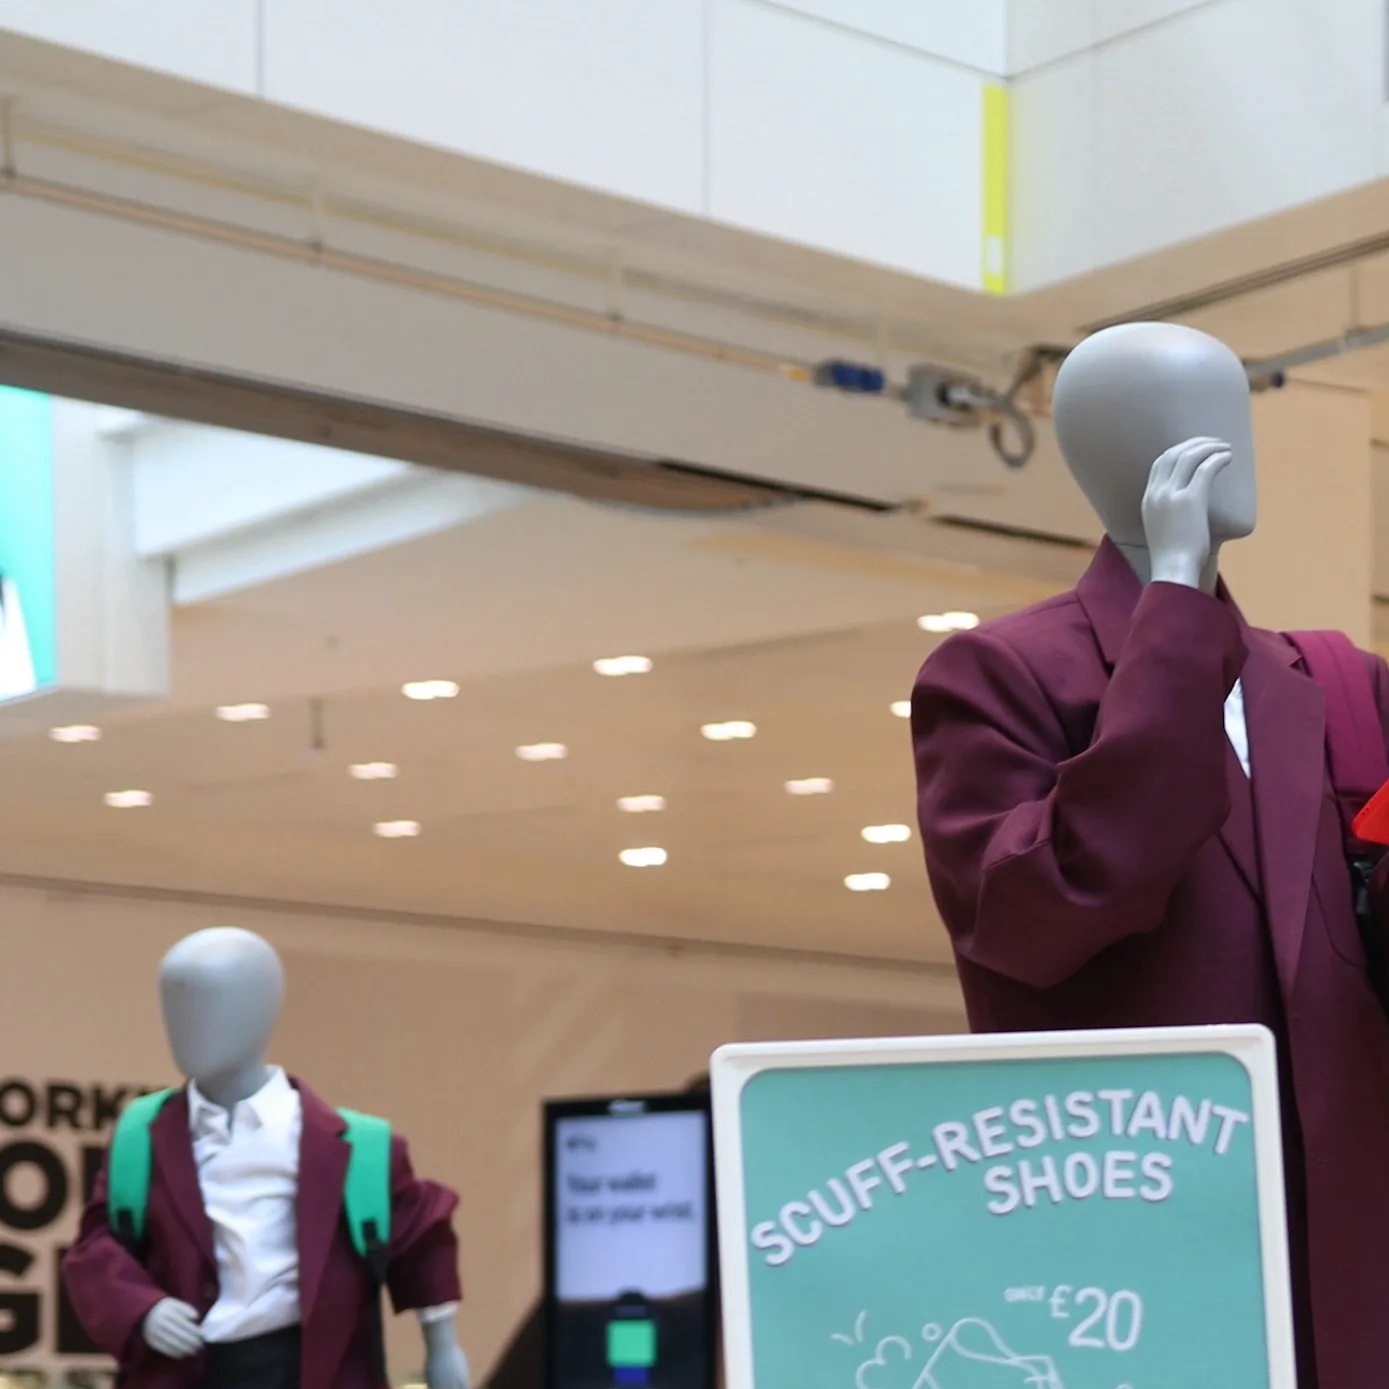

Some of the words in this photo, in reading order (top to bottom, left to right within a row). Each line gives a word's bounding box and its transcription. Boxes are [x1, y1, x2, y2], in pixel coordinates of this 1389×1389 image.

[749, 1088, 1248, 1268] SCUFF-RESISTANT
[983, 1150, 1174, 1216] SHOES
[1047, 1284, 1144, 1352] £20
